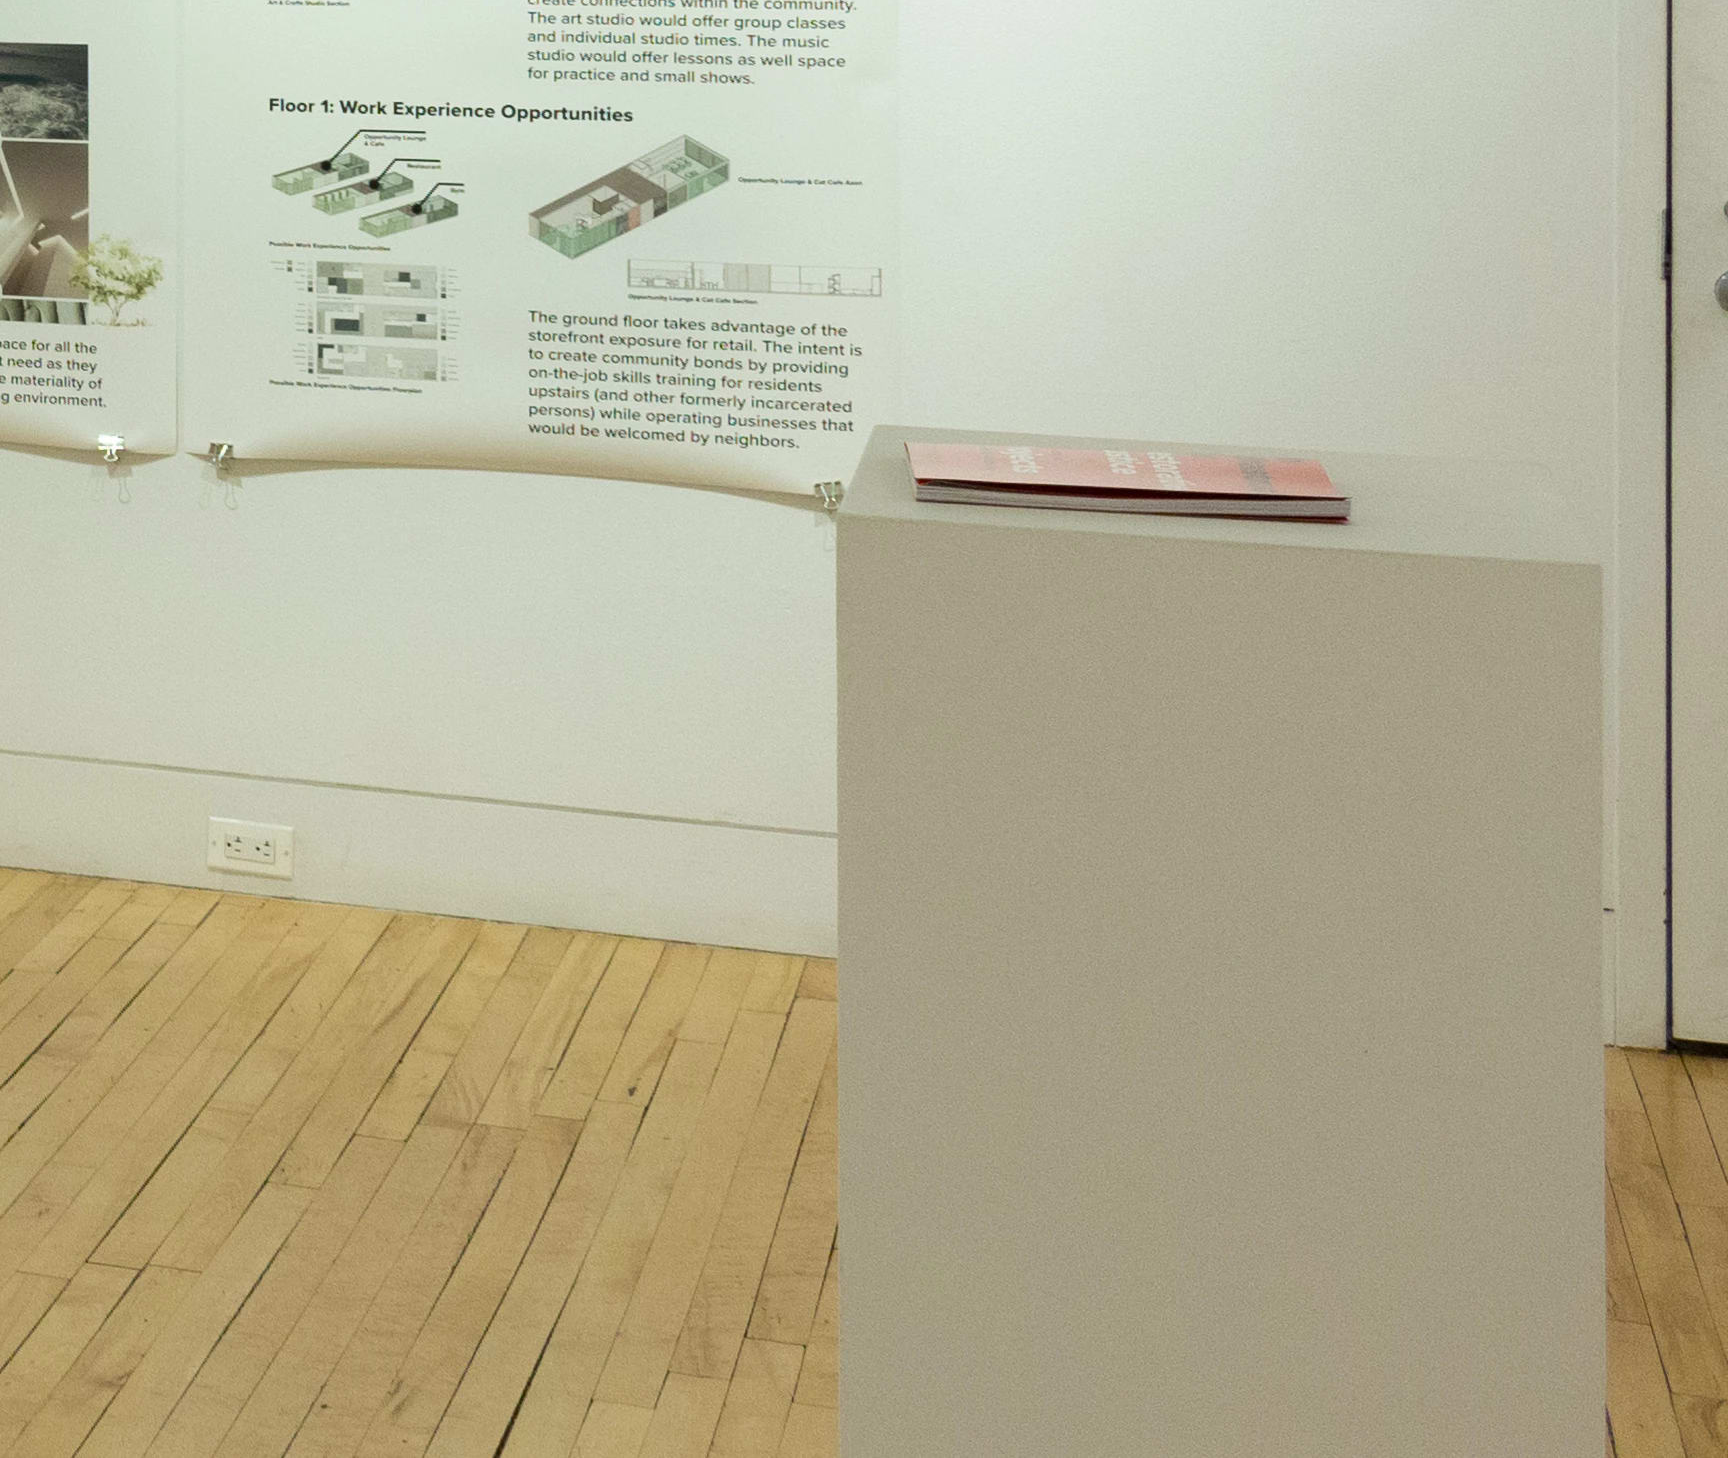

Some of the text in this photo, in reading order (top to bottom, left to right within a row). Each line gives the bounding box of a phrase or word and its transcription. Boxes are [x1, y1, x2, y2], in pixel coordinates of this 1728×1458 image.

[270, 98, 633, 122] Floor 1: Work Experience Opportunities
